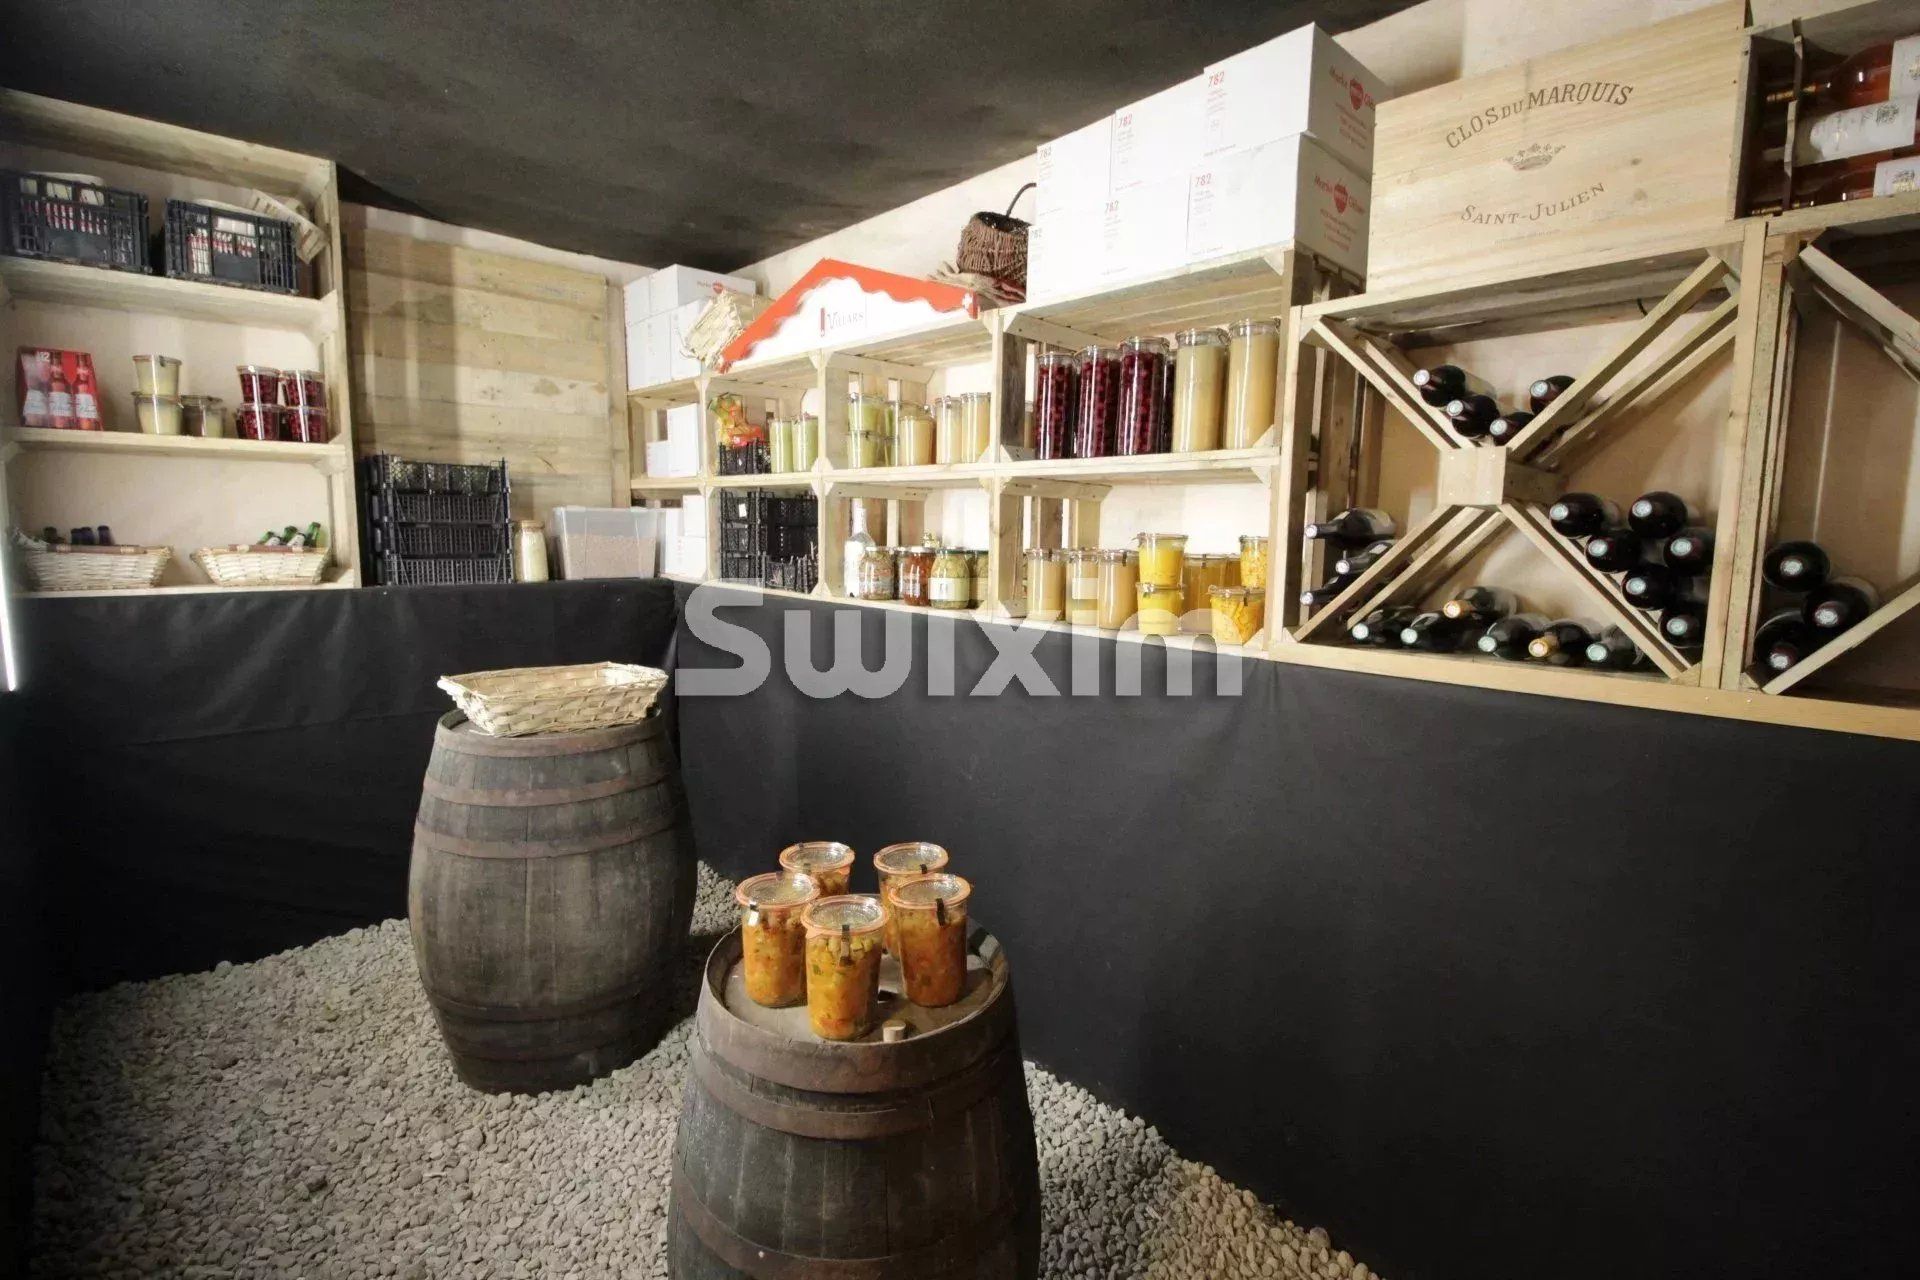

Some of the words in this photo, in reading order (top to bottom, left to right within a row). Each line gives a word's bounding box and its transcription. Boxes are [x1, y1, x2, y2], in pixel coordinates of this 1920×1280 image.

[1207, 72, 1225, 88] 782
[1117, 114, 1133, 129] 782
[1446, 106, 1499, 148] CLOS
[1501, 101, 1523, 119] DU
[1527, 82, 1634, 110] MARQUIS
[1194, 173, 1212, 188] 782
[1104, 200, 1119, 214] 782
[1461, 182, 1605, 225] SAINT-JULIEN
